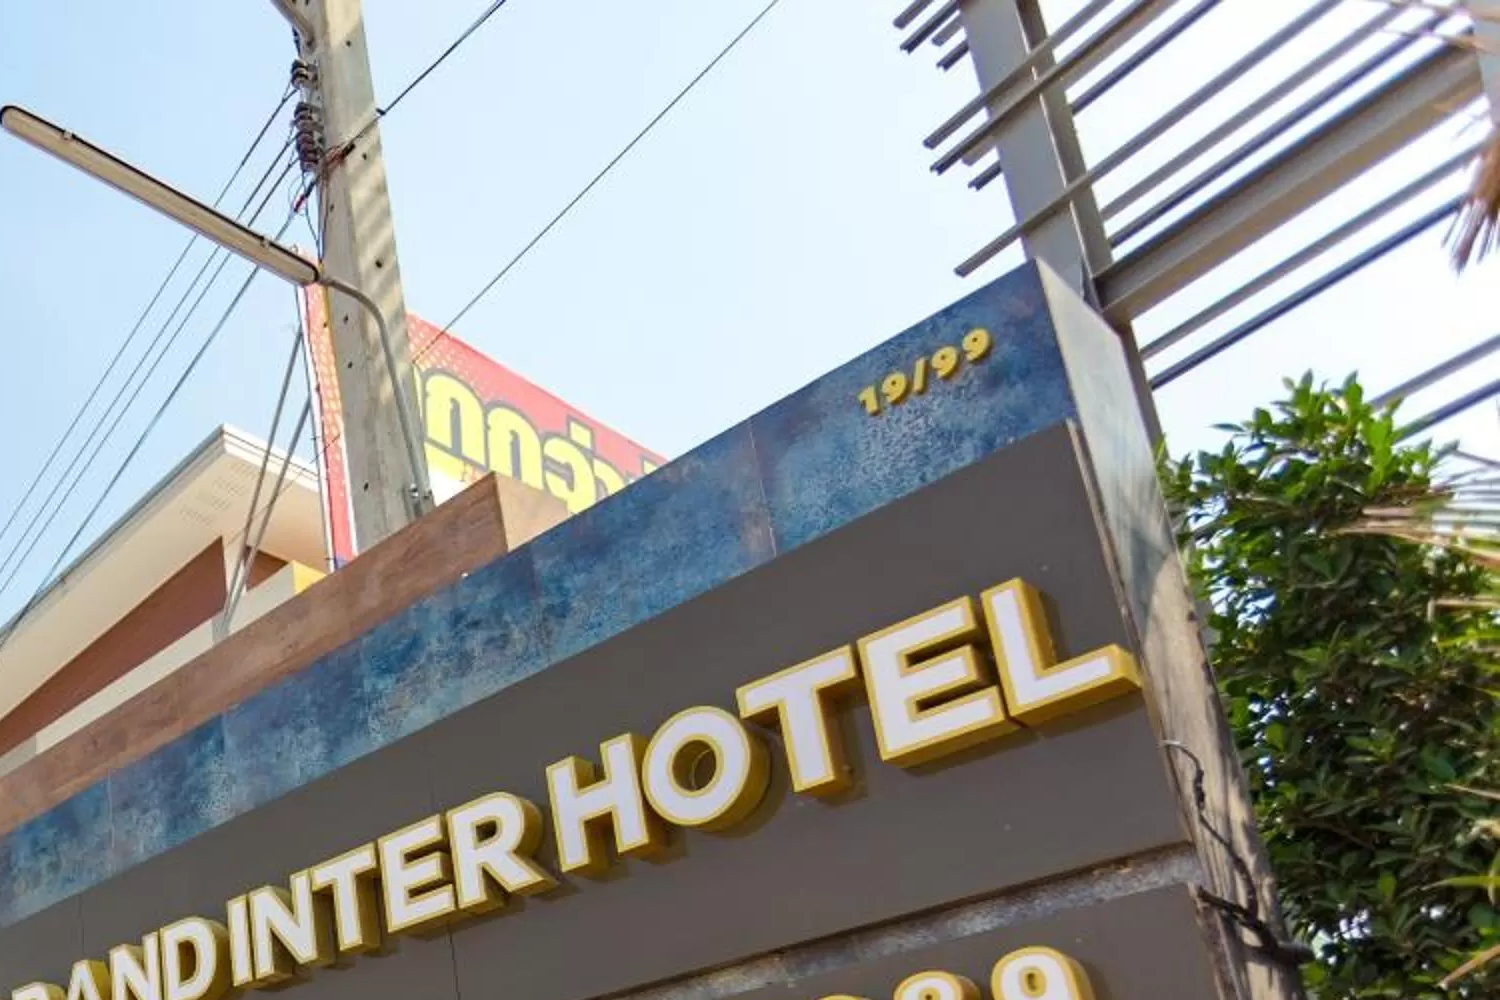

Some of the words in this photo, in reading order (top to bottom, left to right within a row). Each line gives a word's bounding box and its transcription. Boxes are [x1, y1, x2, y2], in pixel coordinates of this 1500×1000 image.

[858, 327, 993, 416] 19/99
[227, 791, 555, 988] INTER
[546, 577, 1143, 872] HOTEL
